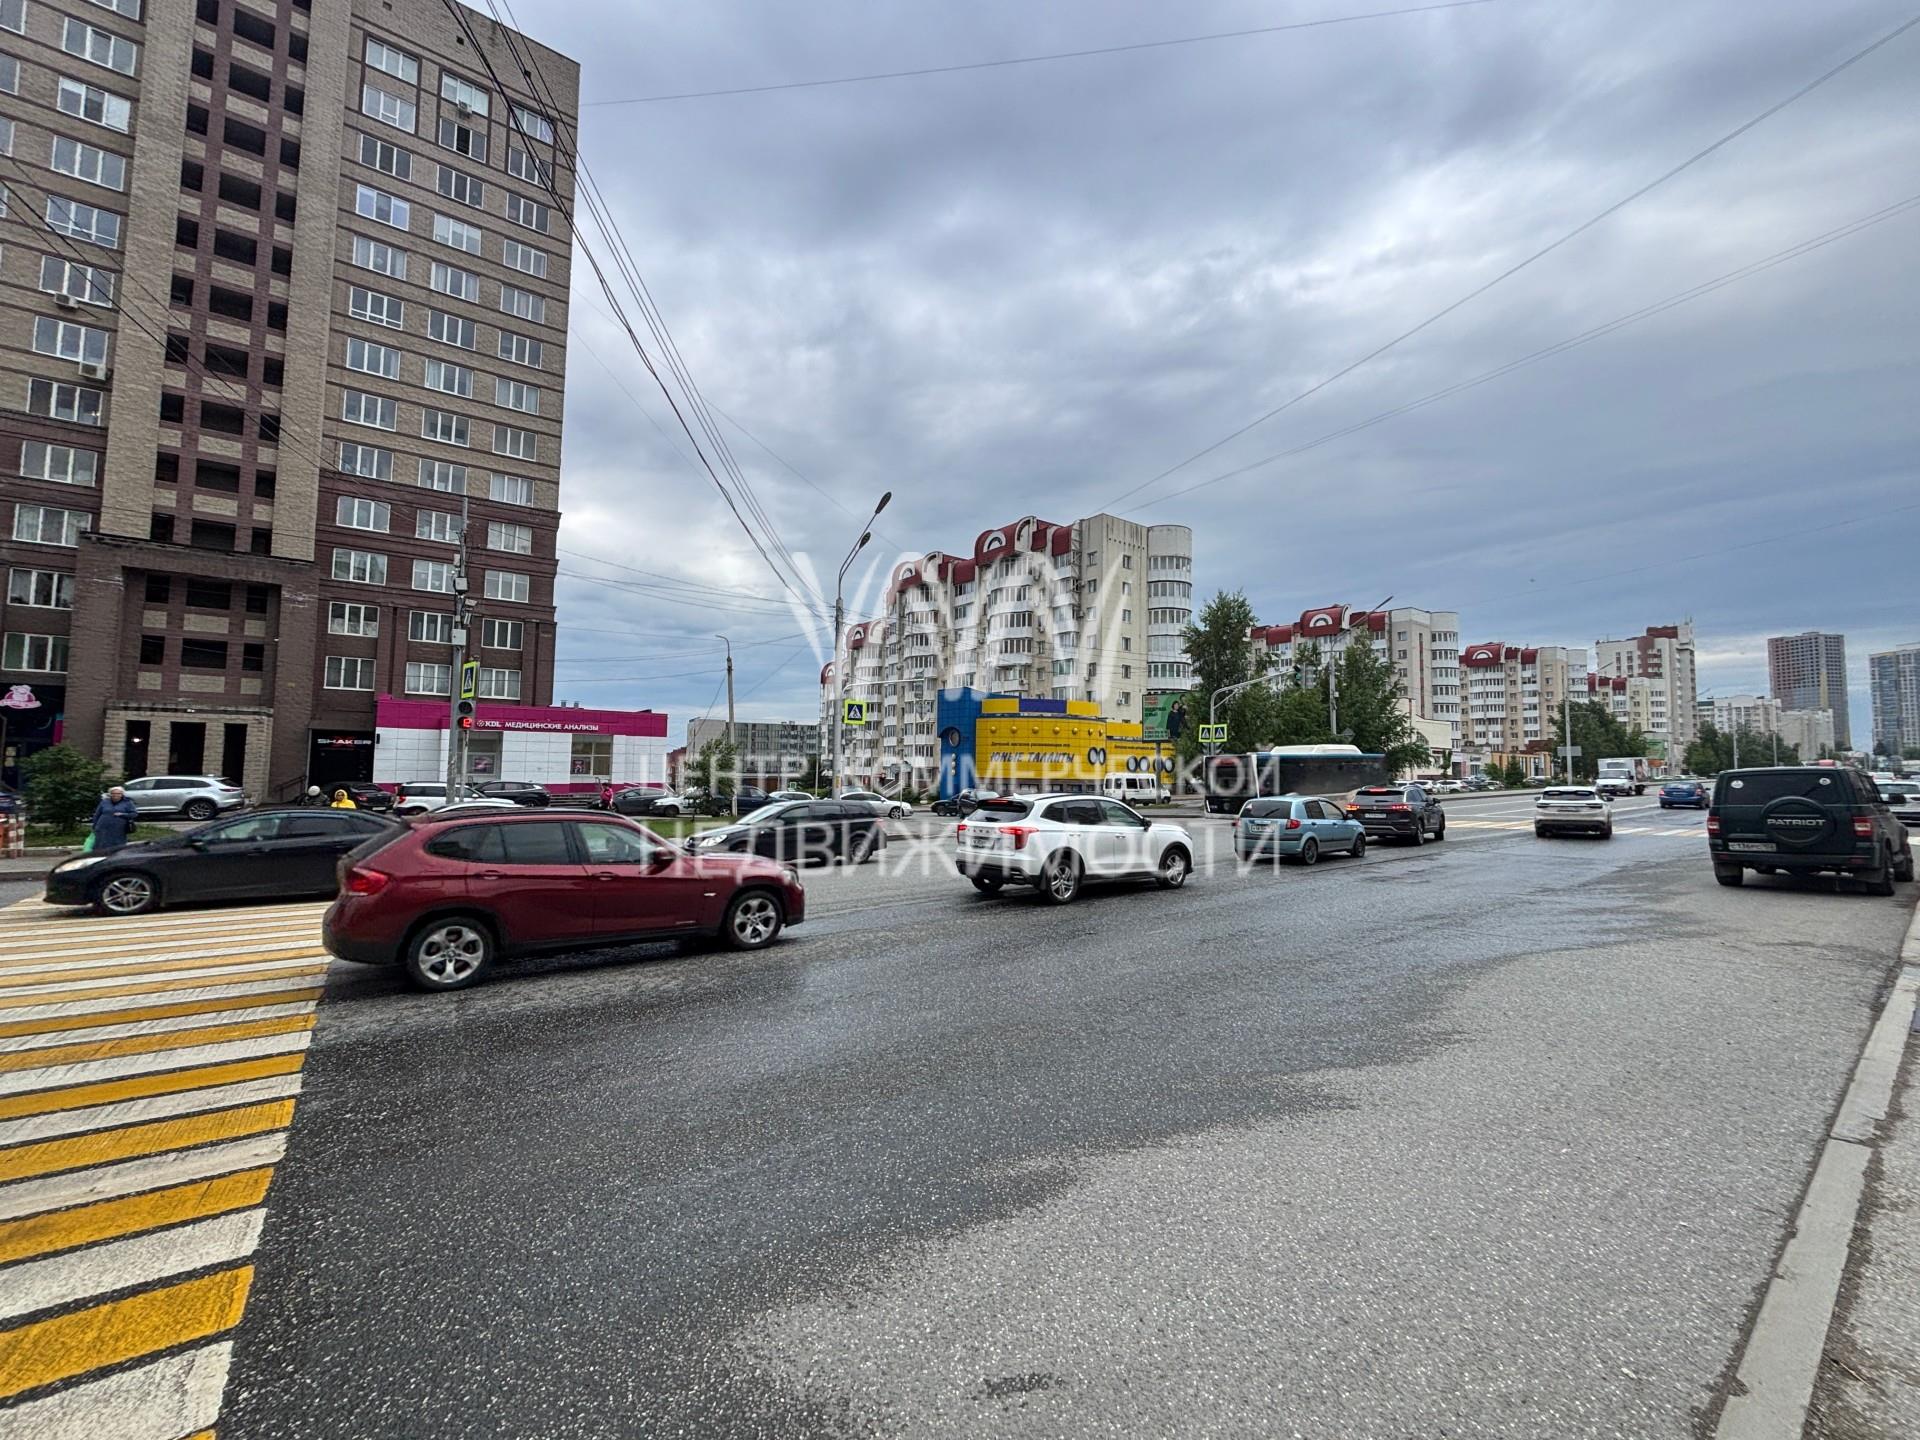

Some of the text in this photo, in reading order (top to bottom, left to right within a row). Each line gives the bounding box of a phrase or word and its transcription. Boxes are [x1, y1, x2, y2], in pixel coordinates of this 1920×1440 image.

[504, 721, 599, 731] МЕДИЦИНСКИЕ АНАЛИЗЫ
[991, 751, 1075, 763] ЮНЫЕ ТАЛАНТЫ
[1767, 818, 1826, 826] PATRIOT
